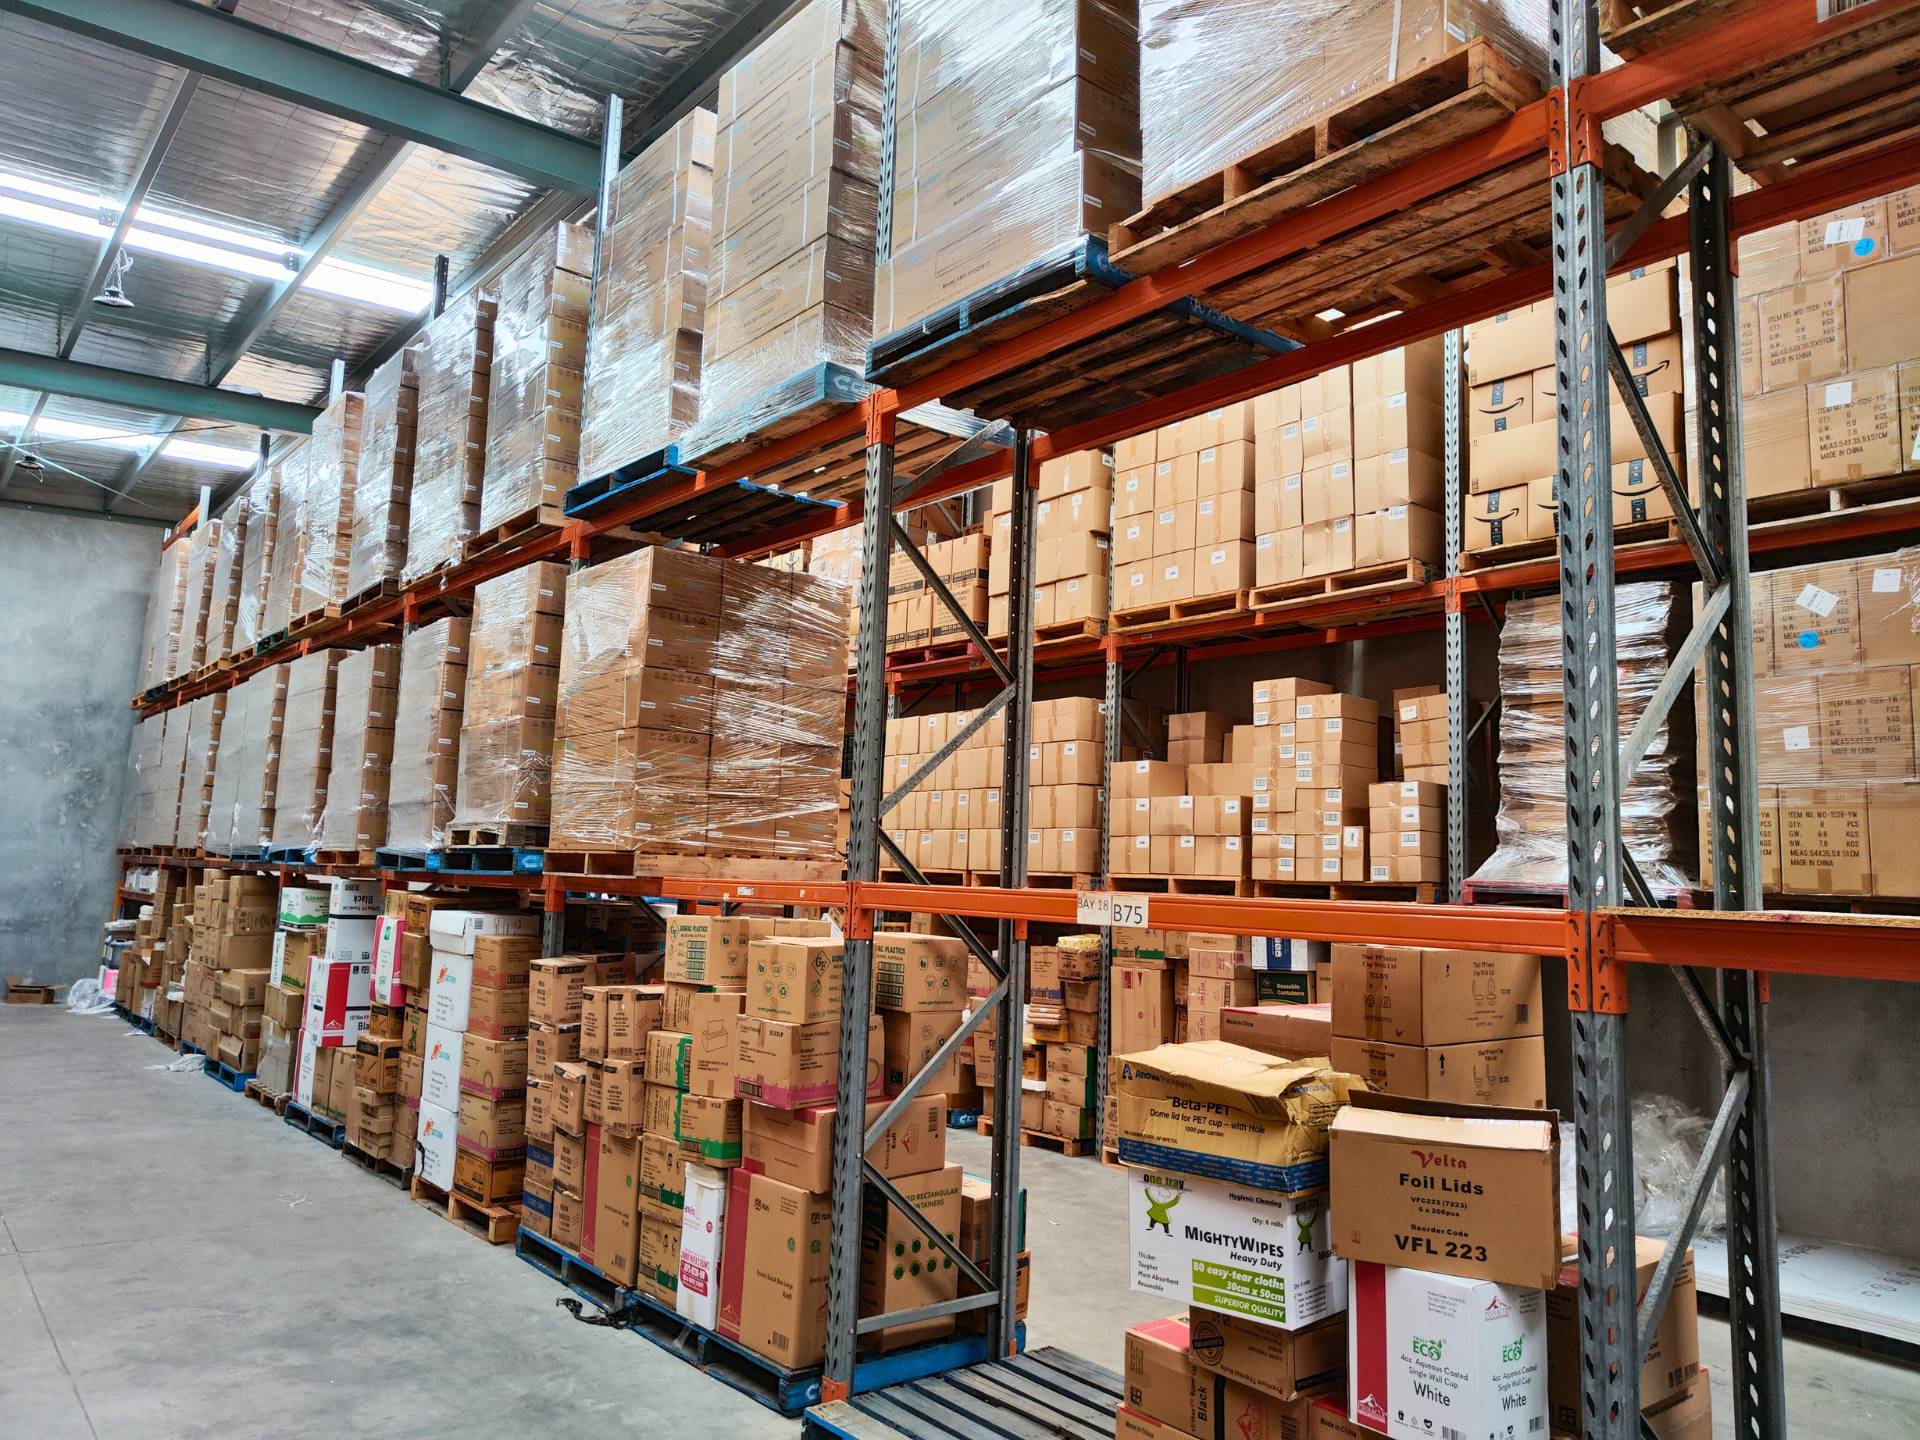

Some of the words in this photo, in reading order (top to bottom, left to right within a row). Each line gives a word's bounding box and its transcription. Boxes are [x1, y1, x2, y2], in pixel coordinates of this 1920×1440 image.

[1874, 413, 1888, 421] KGS
[1876, 422, 1888, 431] KGS
[1821, 452, 1836, 460] MADE
[1847, 446, 1864, 456] CHINA
[353, 896, 373, 904] Black
[1078, 898, 1095, 910] BAY
[1098, 899, 1108, 911] 18
[1114, 904, 1143, 924] B75
[358, 1022, 369, 1032] Bla
[1150, 1108, 1170, 1120] Dome
[1171, 1111, 1180, 1120] lid
[1181, 1112, 1192, 1122] for
[1192, 1115, 1207, 1125] PET
[1208, 1118, 1222, 1128] cup
[1230, 1121, 1246, 1132] with
[1248, 1124, 1265, 1134] Hole
[1411, 1150, 1468, 1168] Velta
[1144, 1174, 1162, 1187] one
[1165, 1176, 1184, 1190] tray
[1399, 1173, 1434, 1190] Foil
[1441, 1177, 1484, 1195] Lids
[1229, 1192, 1254, 1204] Hygienic
[1255, 1196, 1282, 1208] Cleaning
[1252, 1216, 1263, 1225] Qty:
[1271, 1220, 1283, 1228] rolls
[1411, 1224, 1445, 1236] Reorder
[1447, 1228, 1468, 1238] Code
[1138, 1252, 1156, 1261] Thicker
[1395, 1234, 1438, 1255] VFL
[1444, 1242, 1488, 1262] 223
[1138, 1261, 1158, 1272] Tougher
[1230, 1252, 1258, 1266] Heavy
[1260, 1258, 1282, 1272] Duty
[1138, 1270, 1152, 1278] More
[1152, 1273, 1179, 1286] Absorbent
[1193, 1260, 1204, 1272] 80
[1206, 1264, 1252, 1284] easy-tear
[1254, 1274, 1284, 1290] cloths
[1226, 1280, 1250, 1294] 30cm
[1252, 1288, 1258, 1296] x
[1259, 1289, 1284, 1302] 50cm
[1214, 1295, 1250, 1312] SUPERIOR
[1251, 1302, 1284, 1319] QUALITY
[1408, 1366, 1427, 1380] Single
[1429, 1372, 1442, 1382] Wall
[1444, 1378, 1458, 1389] Cup
[1416, 1358, 1442, 1374] Aqueous
[1444, 1368, 1469, 1381] Coated
[1257, 1379, 1282, 1395] Premium
[1413, 1380, 1451, 1407] White
[1197, 1386, 1207, 1421] Black
[1502, 1394, 1526, 1411] White
[1320, 1416, 1333, 1428] Made
[1340, 1423, 1357, 1438] China
